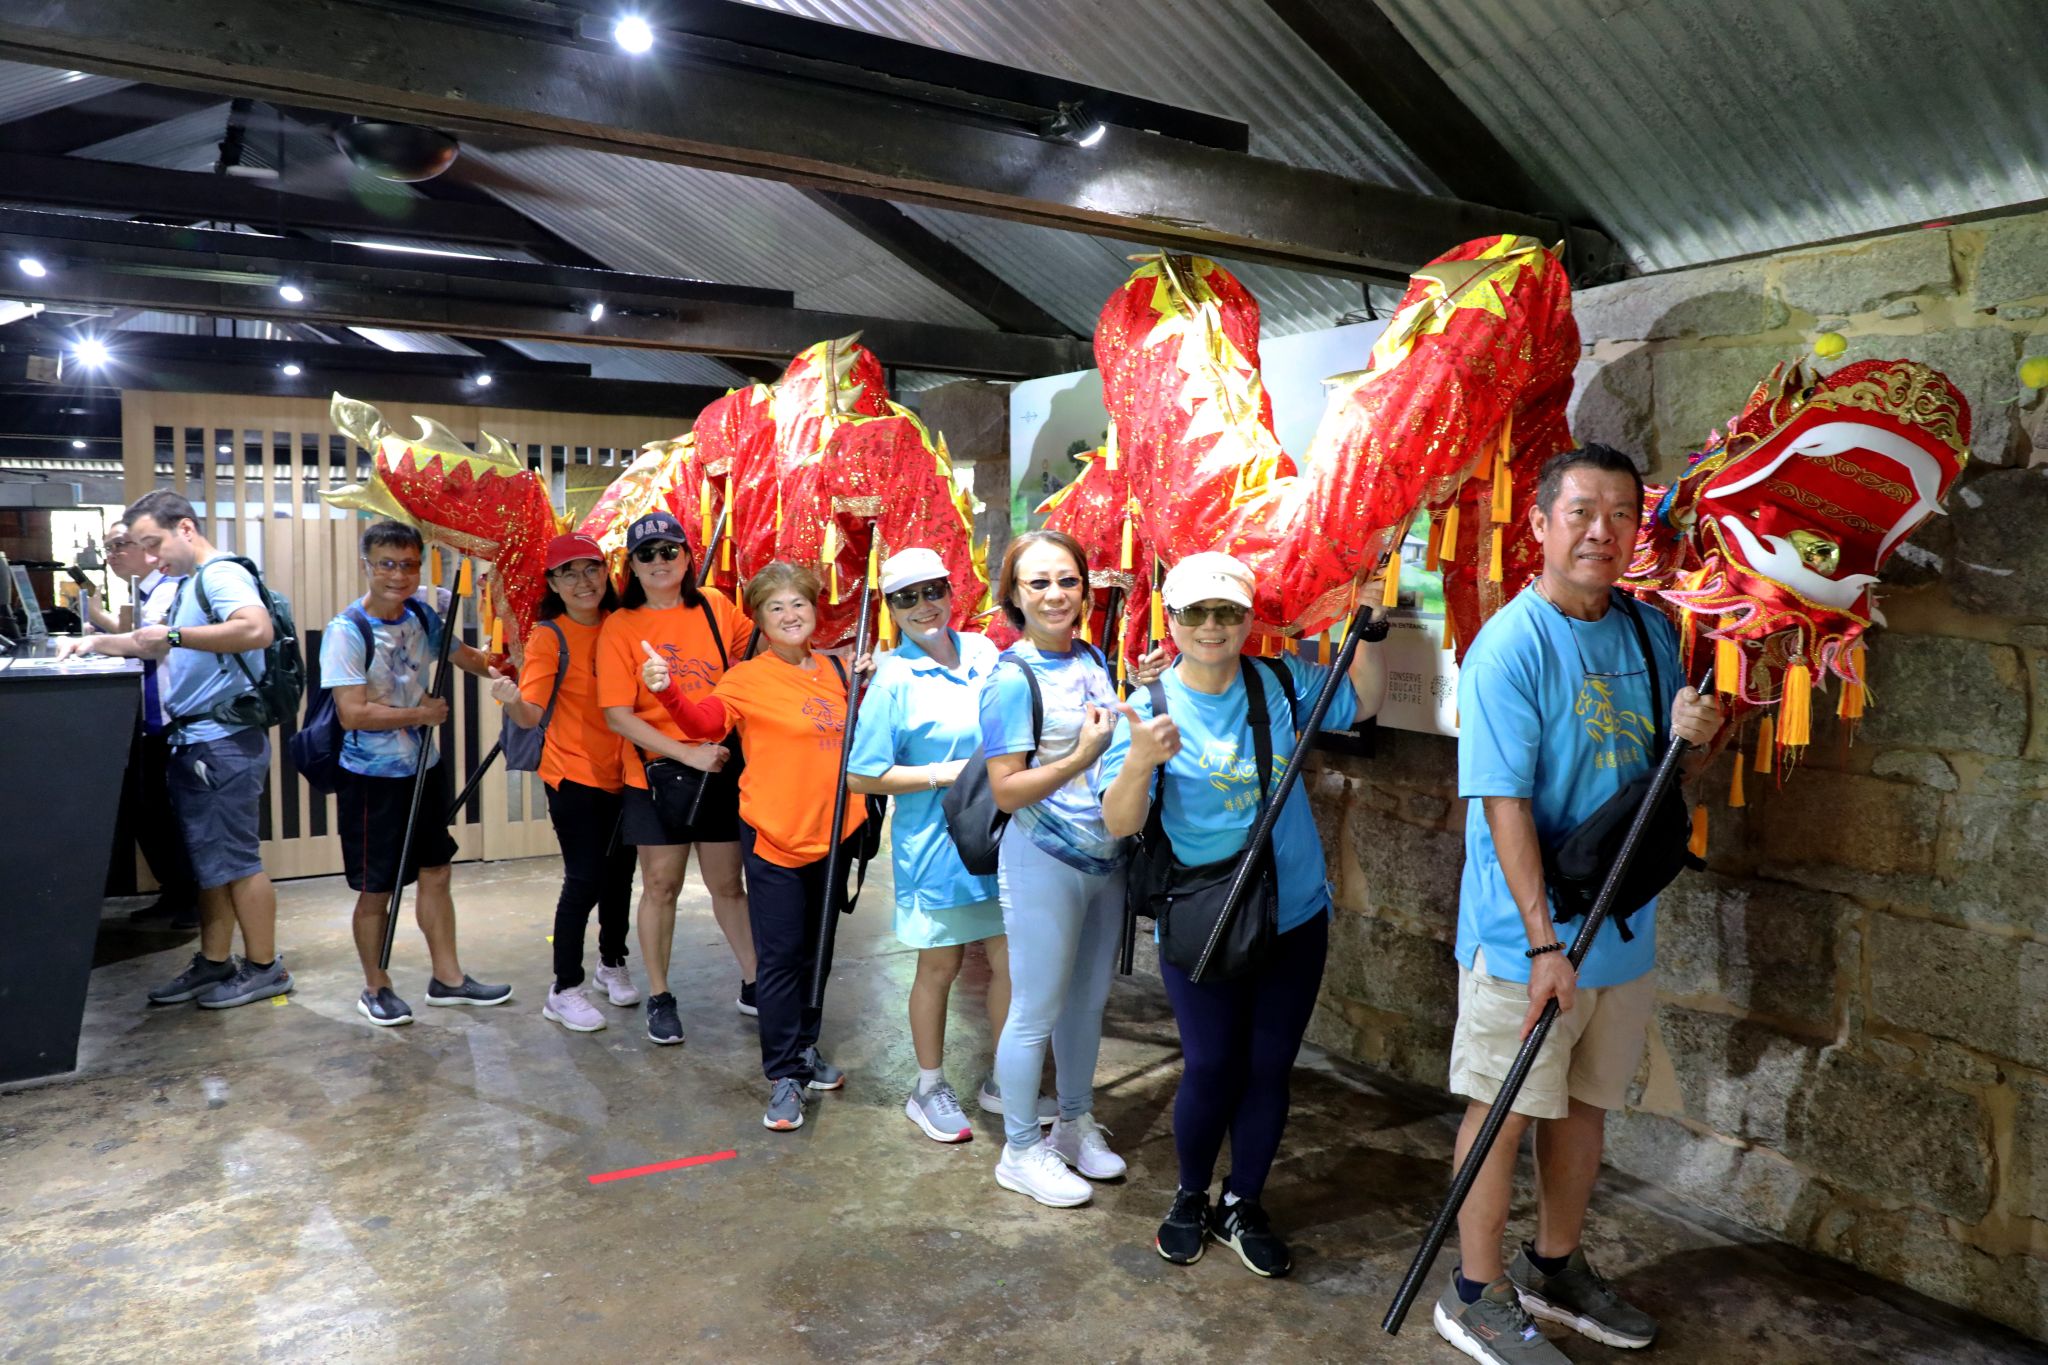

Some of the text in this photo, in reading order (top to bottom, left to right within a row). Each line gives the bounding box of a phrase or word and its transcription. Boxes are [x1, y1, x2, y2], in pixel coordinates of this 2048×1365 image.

[635, 520, 668, 539] GAP
[1399, 622, 1428, 630] ENTRANCE
[1389, 671, 1422, 684] CONSERVE
[1389, 681, 1422, 694] EDUCATE
[1388, 691, 1422, 705] INSPIRE
